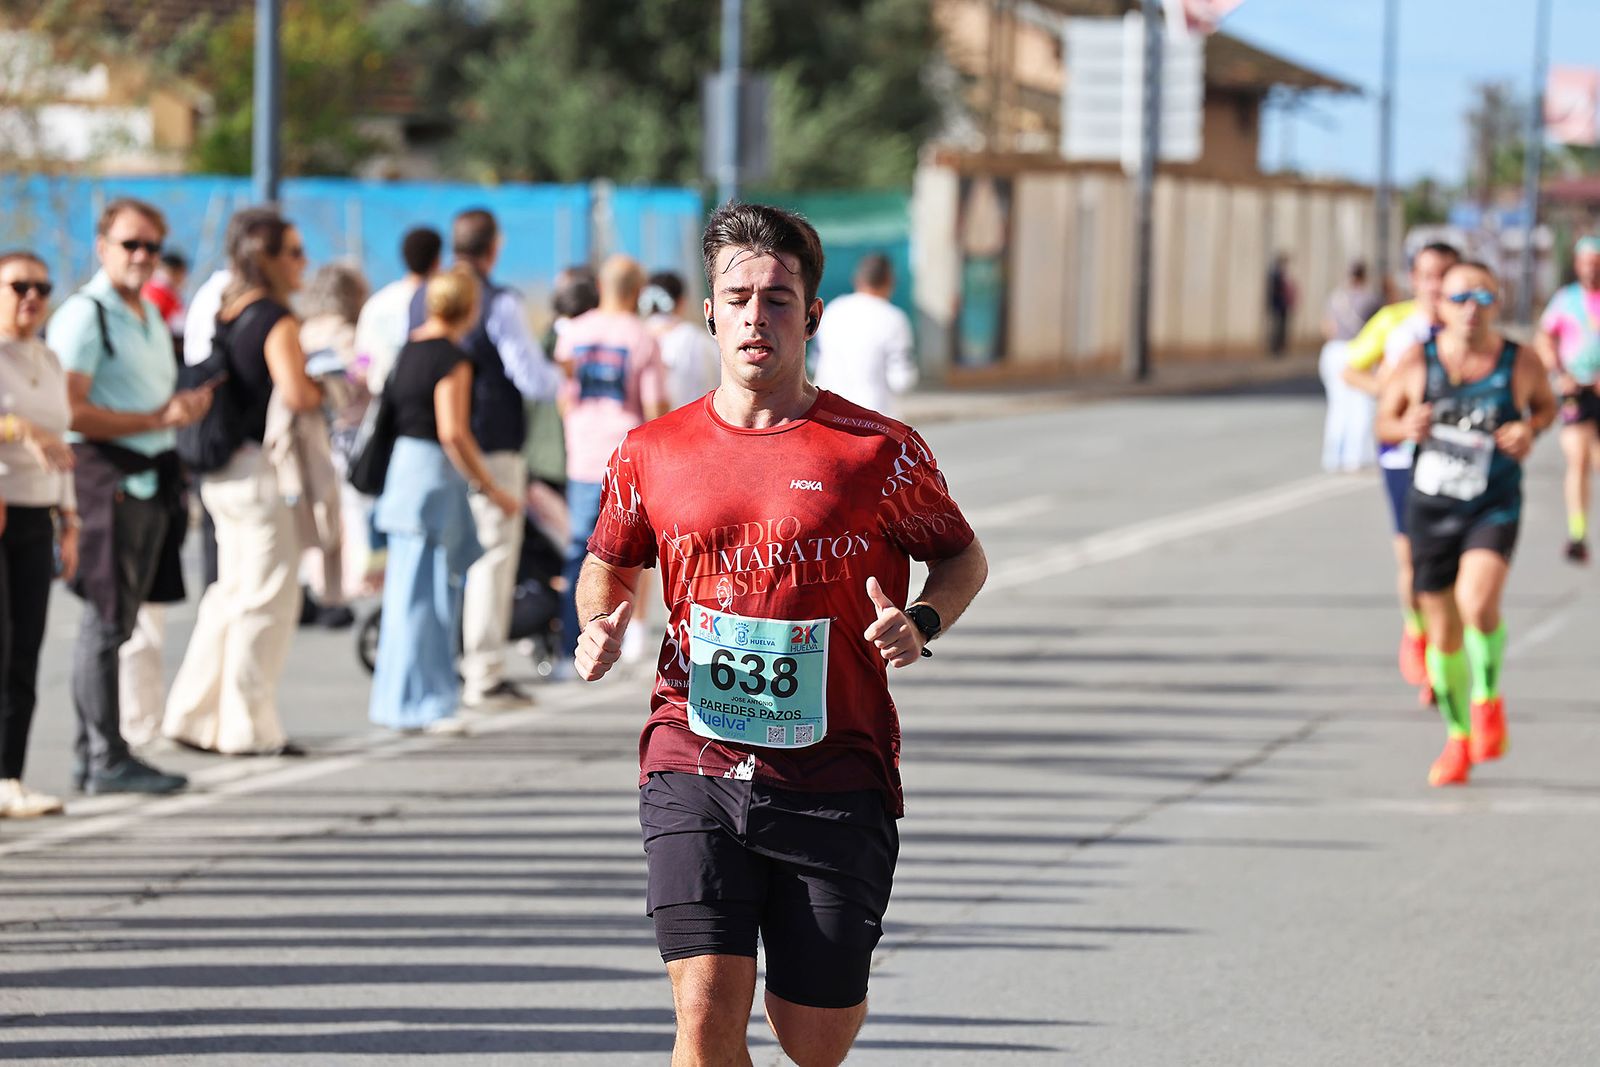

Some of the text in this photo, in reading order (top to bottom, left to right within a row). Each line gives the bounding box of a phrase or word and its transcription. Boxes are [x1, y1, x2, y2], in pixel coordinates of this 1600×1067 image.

[789, 479, 823, 491] HOKA
[690, 515, 802, 552] MEDIO
[718, 531, 870, 575] MARATÓN
[732, 557, 852, 597] SEVILLA
[699, 612, 722, 637] 21K
[790, 624, 819, 644] 21K
[750, 639, 776, 647] HUELVA
[790, 643, 818, 653] HUELVA
[710, 648, 799, 699] 638
[700, 698, 802, 721] PAREDES PAZOS
[731, 696, 774, 708] JOSE ANTONIO
